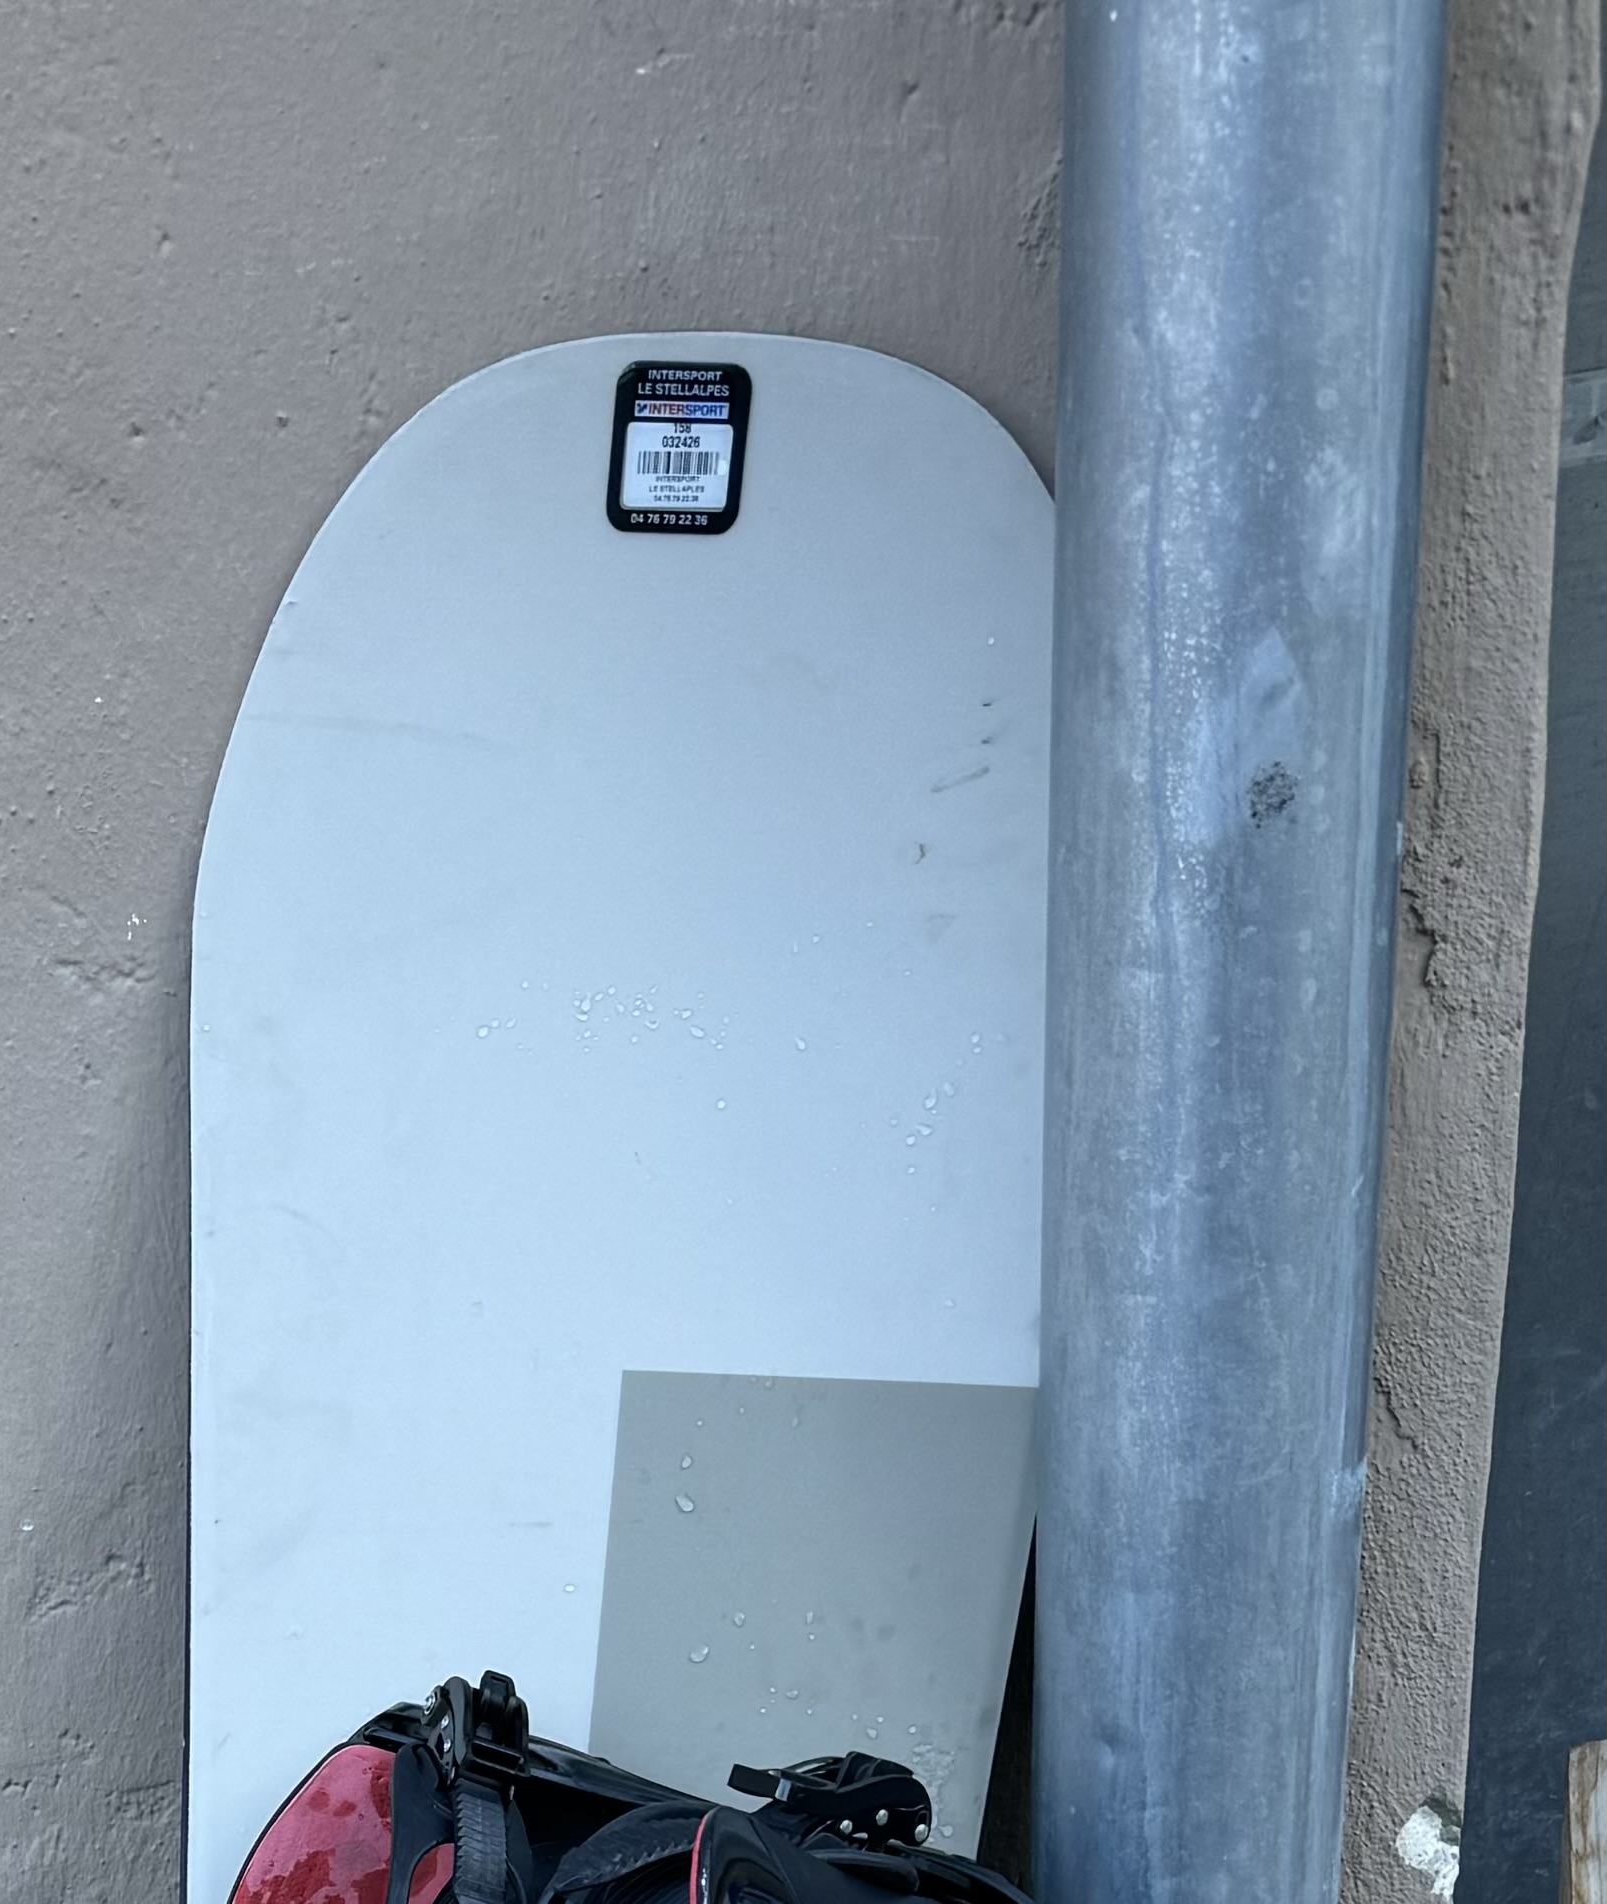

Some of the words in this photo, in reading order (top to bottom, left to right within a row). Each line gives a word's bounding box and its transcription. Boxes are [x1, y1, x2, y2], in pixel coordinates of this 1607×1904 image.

[648, 370, 722, 381] INTERSPORT
[638, 382, 653, 395] LE
[655, 383, 730, 397] STELLALPES
[648, 404, 726, 416] INTERSPORT
[662, 436, 700, 448] 032426
[630, 513, 644, 523] 04
[647, 514, 660, 524] 76
[663, 514, 676, 524] 79
[678, 514, 692, 525] 22
[694, 515, 708, 525] 36
